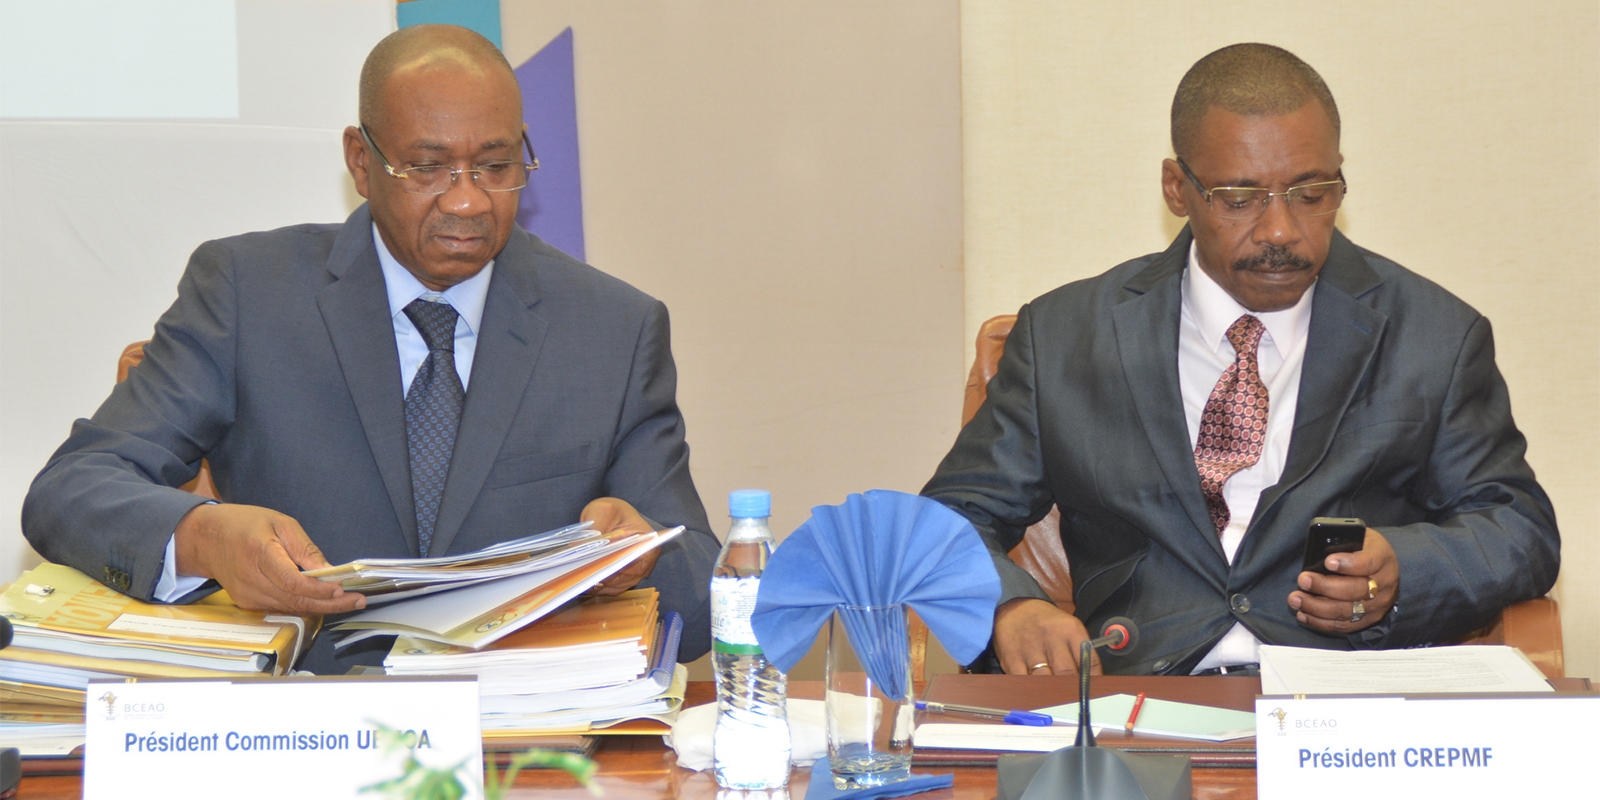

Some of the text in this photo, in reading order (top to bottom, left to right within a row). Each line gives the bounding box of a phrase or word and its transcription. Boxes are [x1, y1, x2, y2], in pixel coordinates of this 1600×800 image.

[124, 703, 165, 713] BCEAO
[1295, 718, 1338, 729] BCEAO
[124, 731, 220, 753] Président
[225, 731, 350, 752] Commission
[1298, 747, 1493, 768] Président CREPMF
